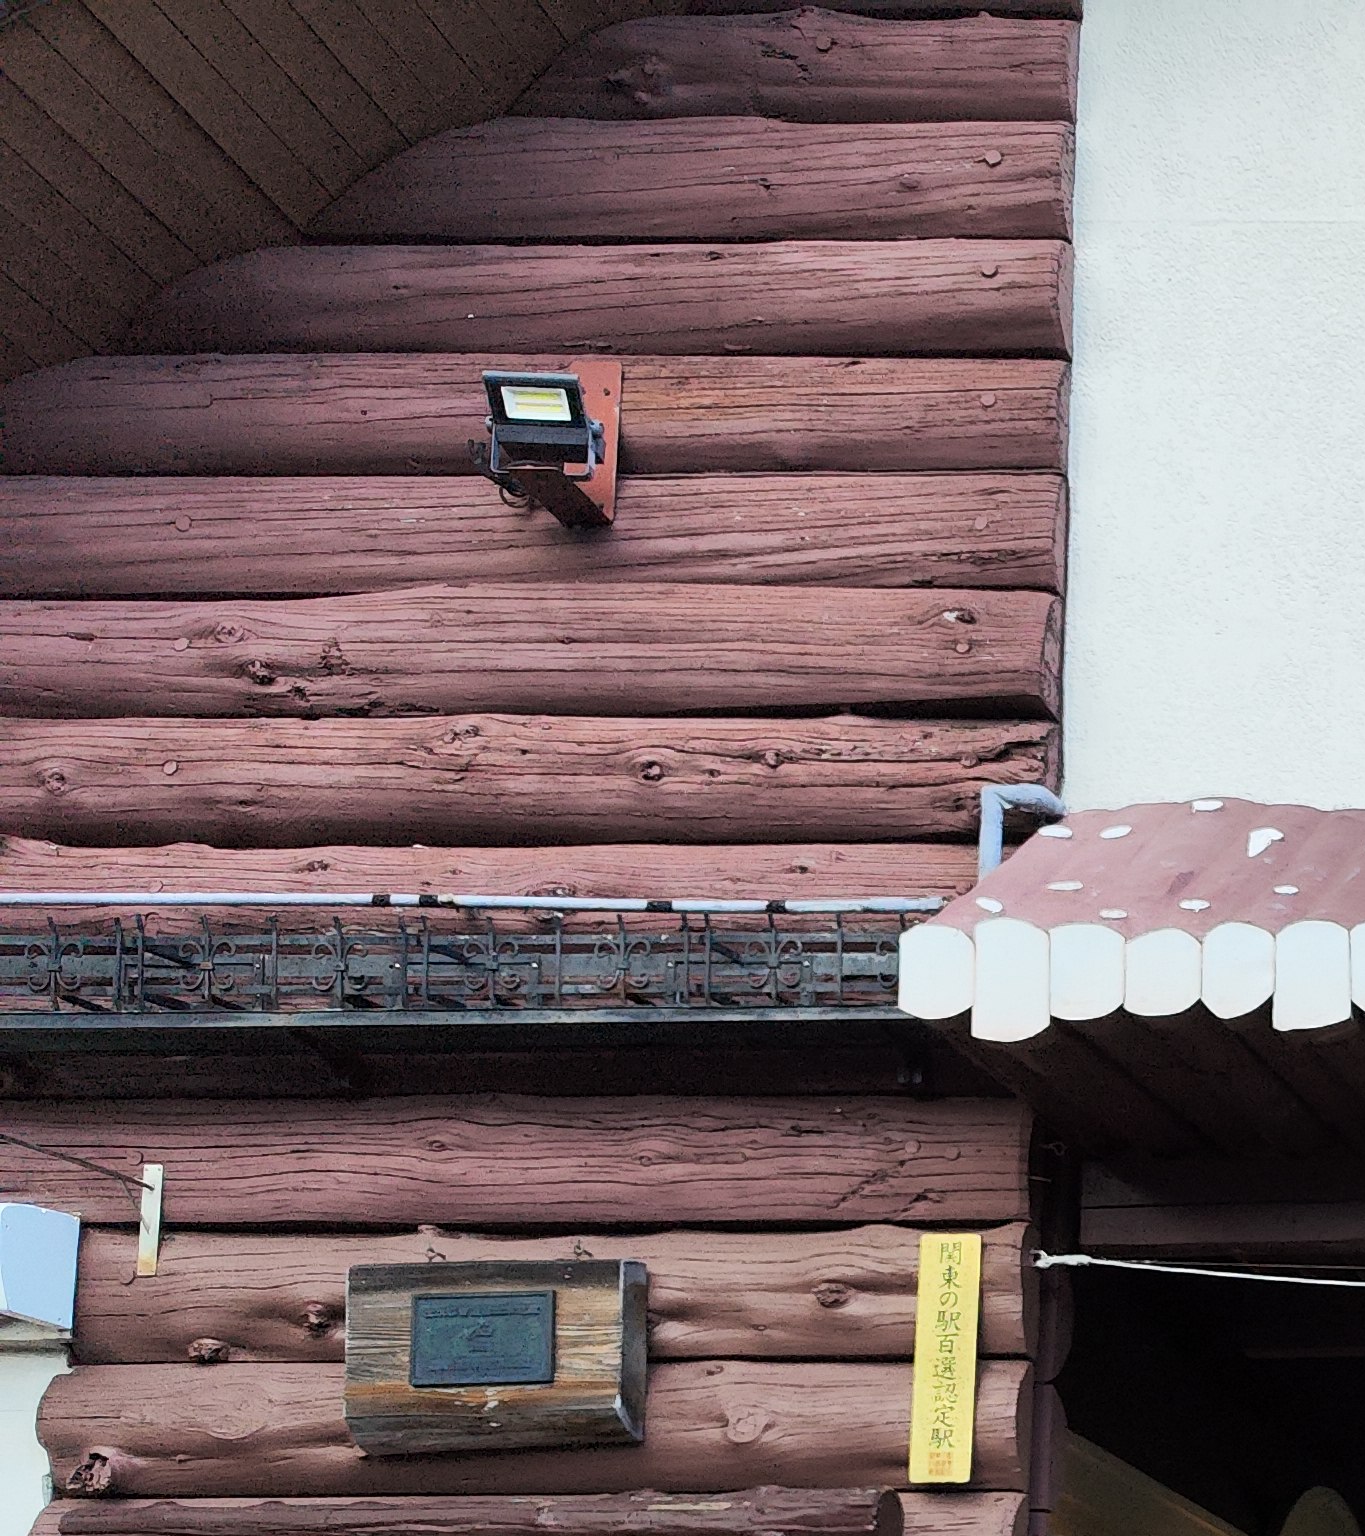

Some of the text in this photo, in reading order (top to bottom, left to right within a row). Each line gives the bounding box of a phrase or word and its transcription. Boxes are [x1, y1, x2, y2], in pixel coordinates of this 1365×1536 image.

[929, 1242, 962, 1450] 関東の駅百選認定駅
